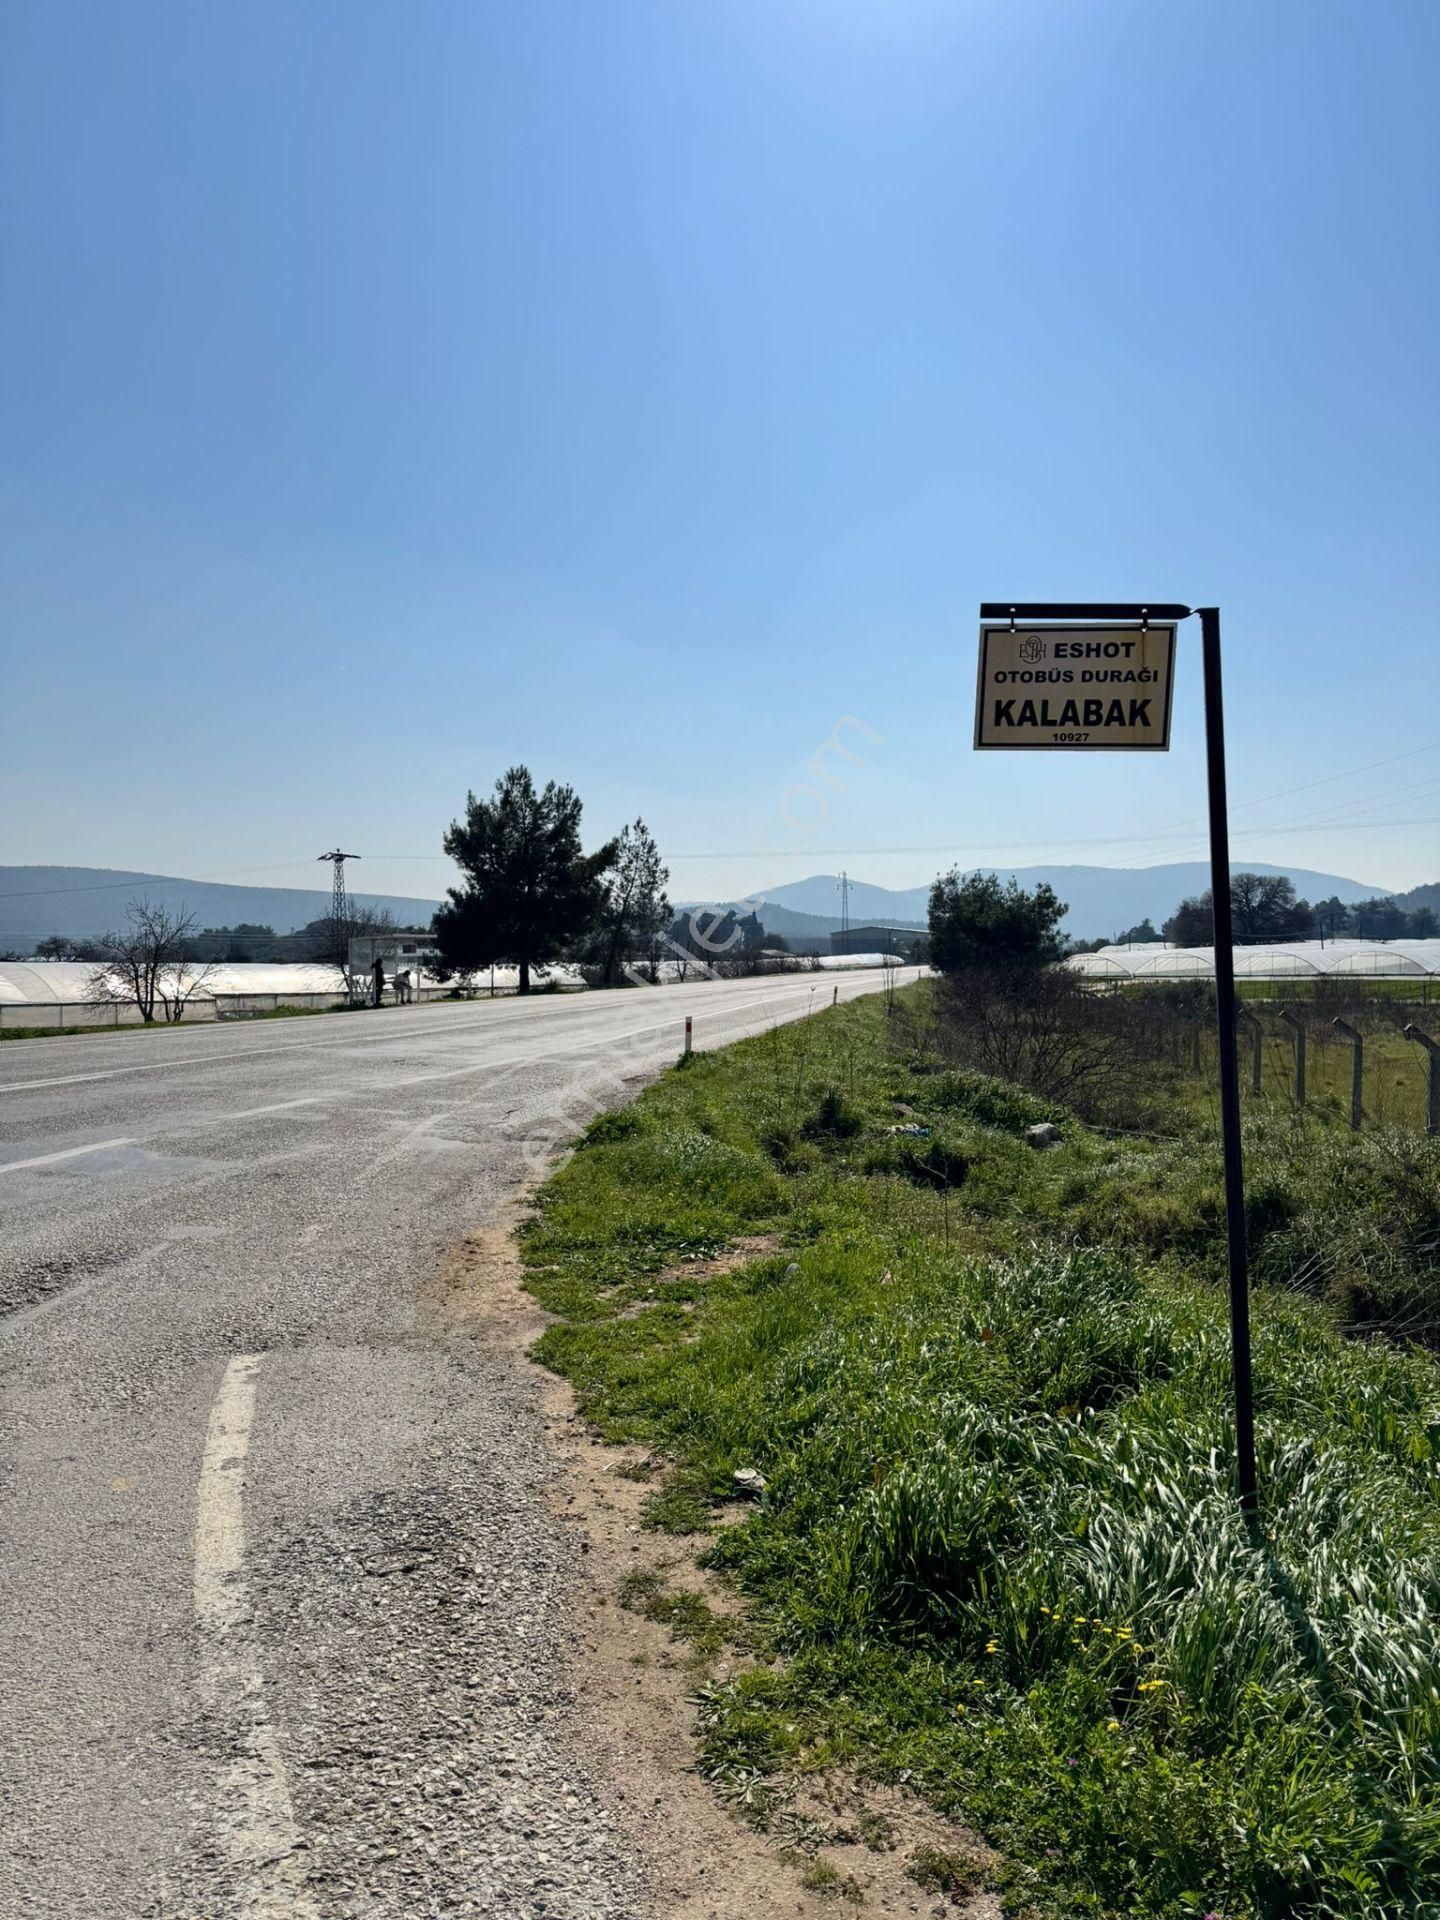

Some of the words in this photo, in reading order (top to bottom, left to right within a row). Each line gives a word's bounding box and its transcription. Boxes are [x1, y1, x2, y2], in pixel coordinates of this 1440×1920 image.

[1054, 642, 1136, 659] ESHOT
[994, 668, 1074, 684] OTOBÜS
[1081, 667, 1159, 683] DURAĞI
[994, 699, 1153, 728] KALABAK
[1052, 733, 1090, 742] 10927
